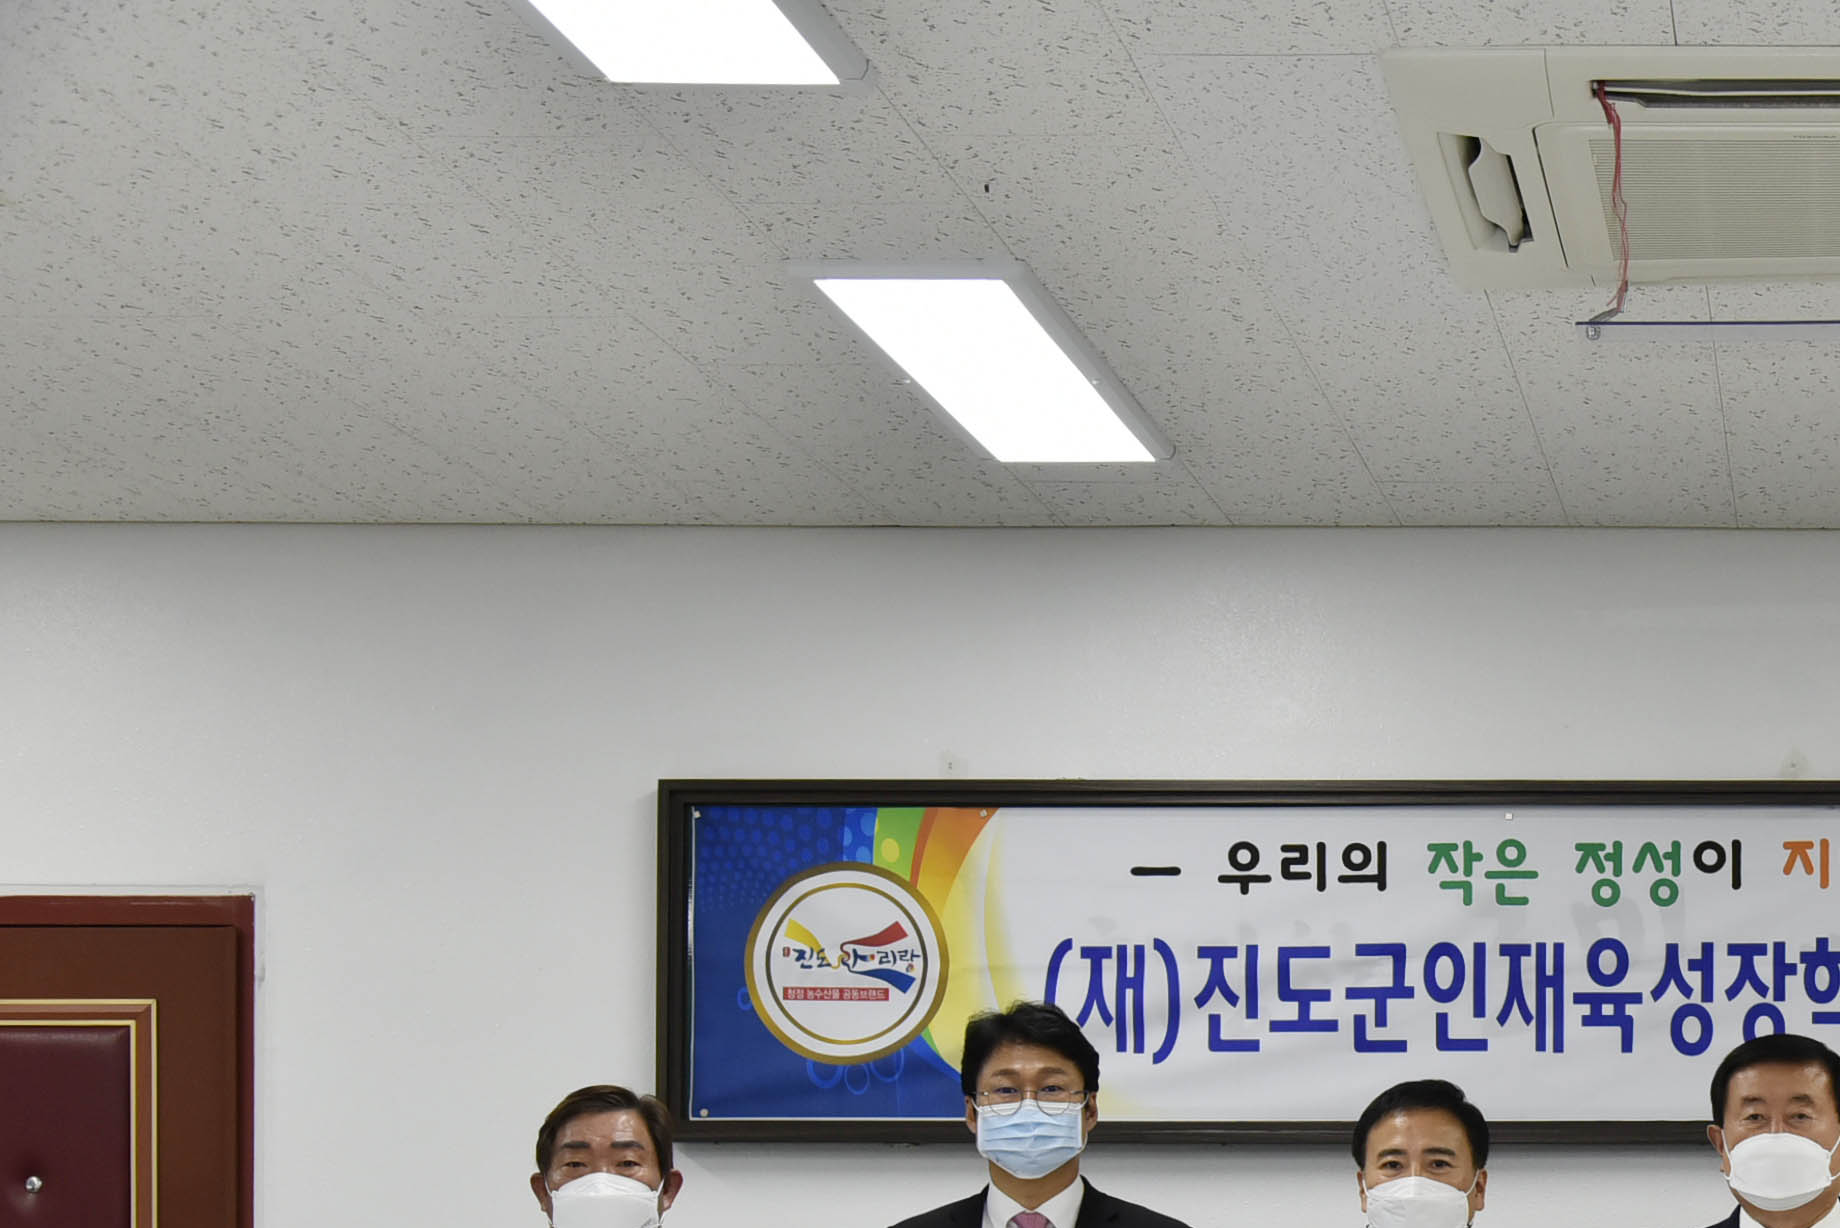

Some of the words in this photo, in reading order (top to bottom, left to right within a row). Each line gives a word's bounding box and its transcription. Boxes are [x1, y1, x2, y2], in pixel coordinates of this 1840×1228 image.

[1217, 839, 1388, 893] 우리의
[1426, 839, 1539, 907] 작은
[1574, 838, 1742, 909] 정성이
